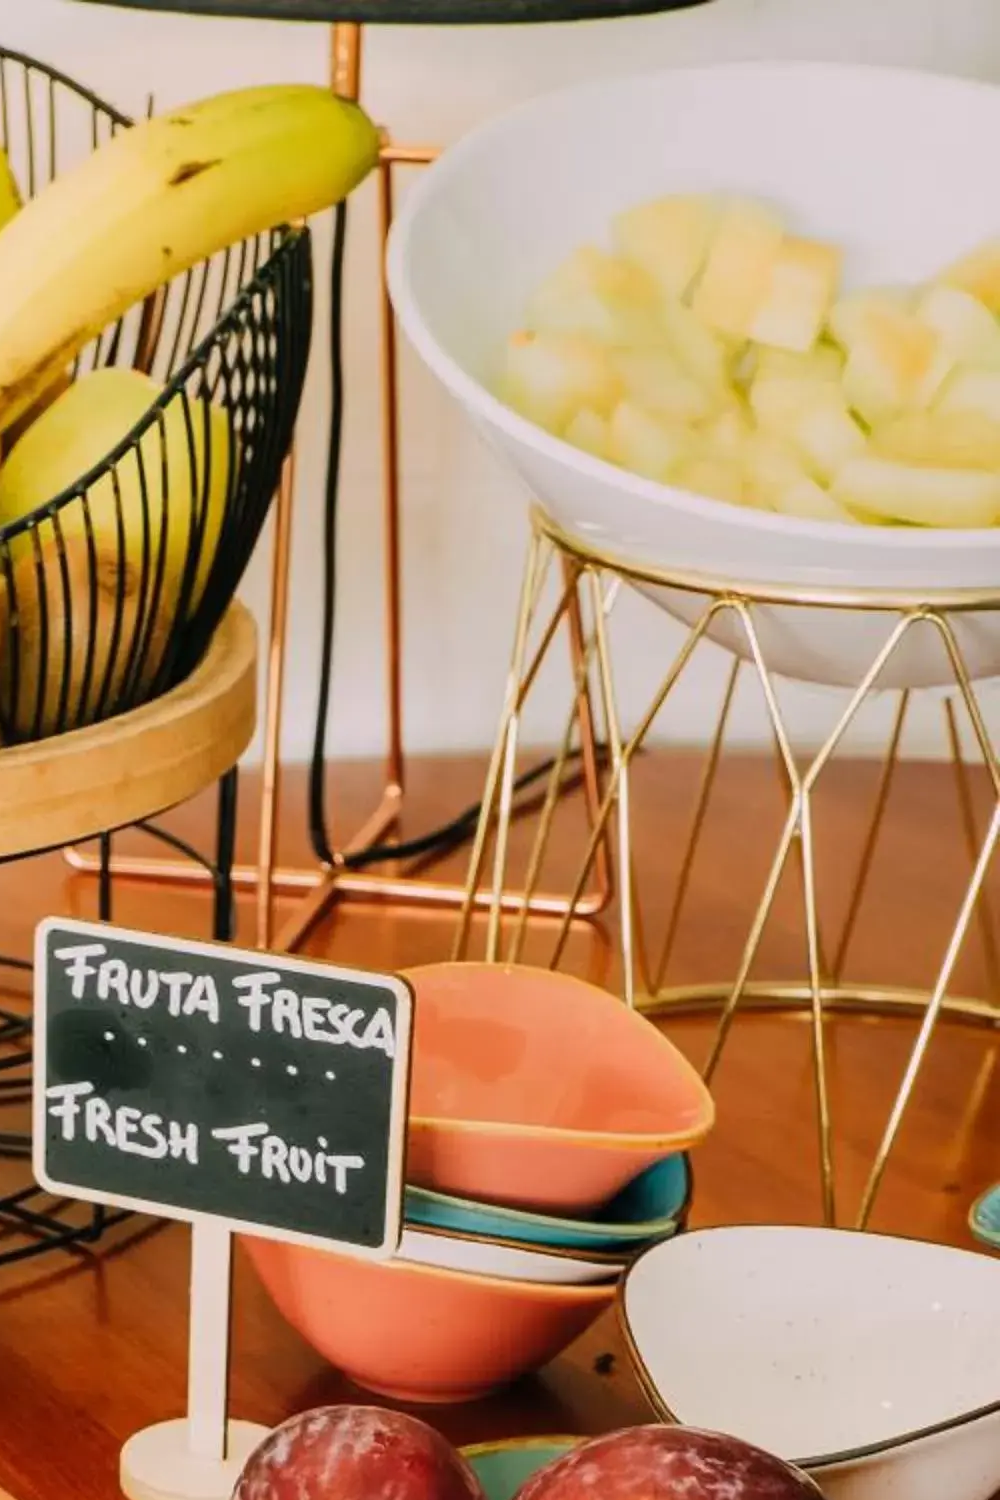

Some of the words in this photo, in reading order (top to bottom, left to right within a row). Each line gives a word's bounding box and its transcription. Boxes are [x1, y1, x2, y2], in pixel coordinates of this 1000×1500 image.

[54, 944, 219, 1024] FRUTA
[232, 972, 396, 1058] FRESCA
[45, 1081, 198, 1164] FRESH
